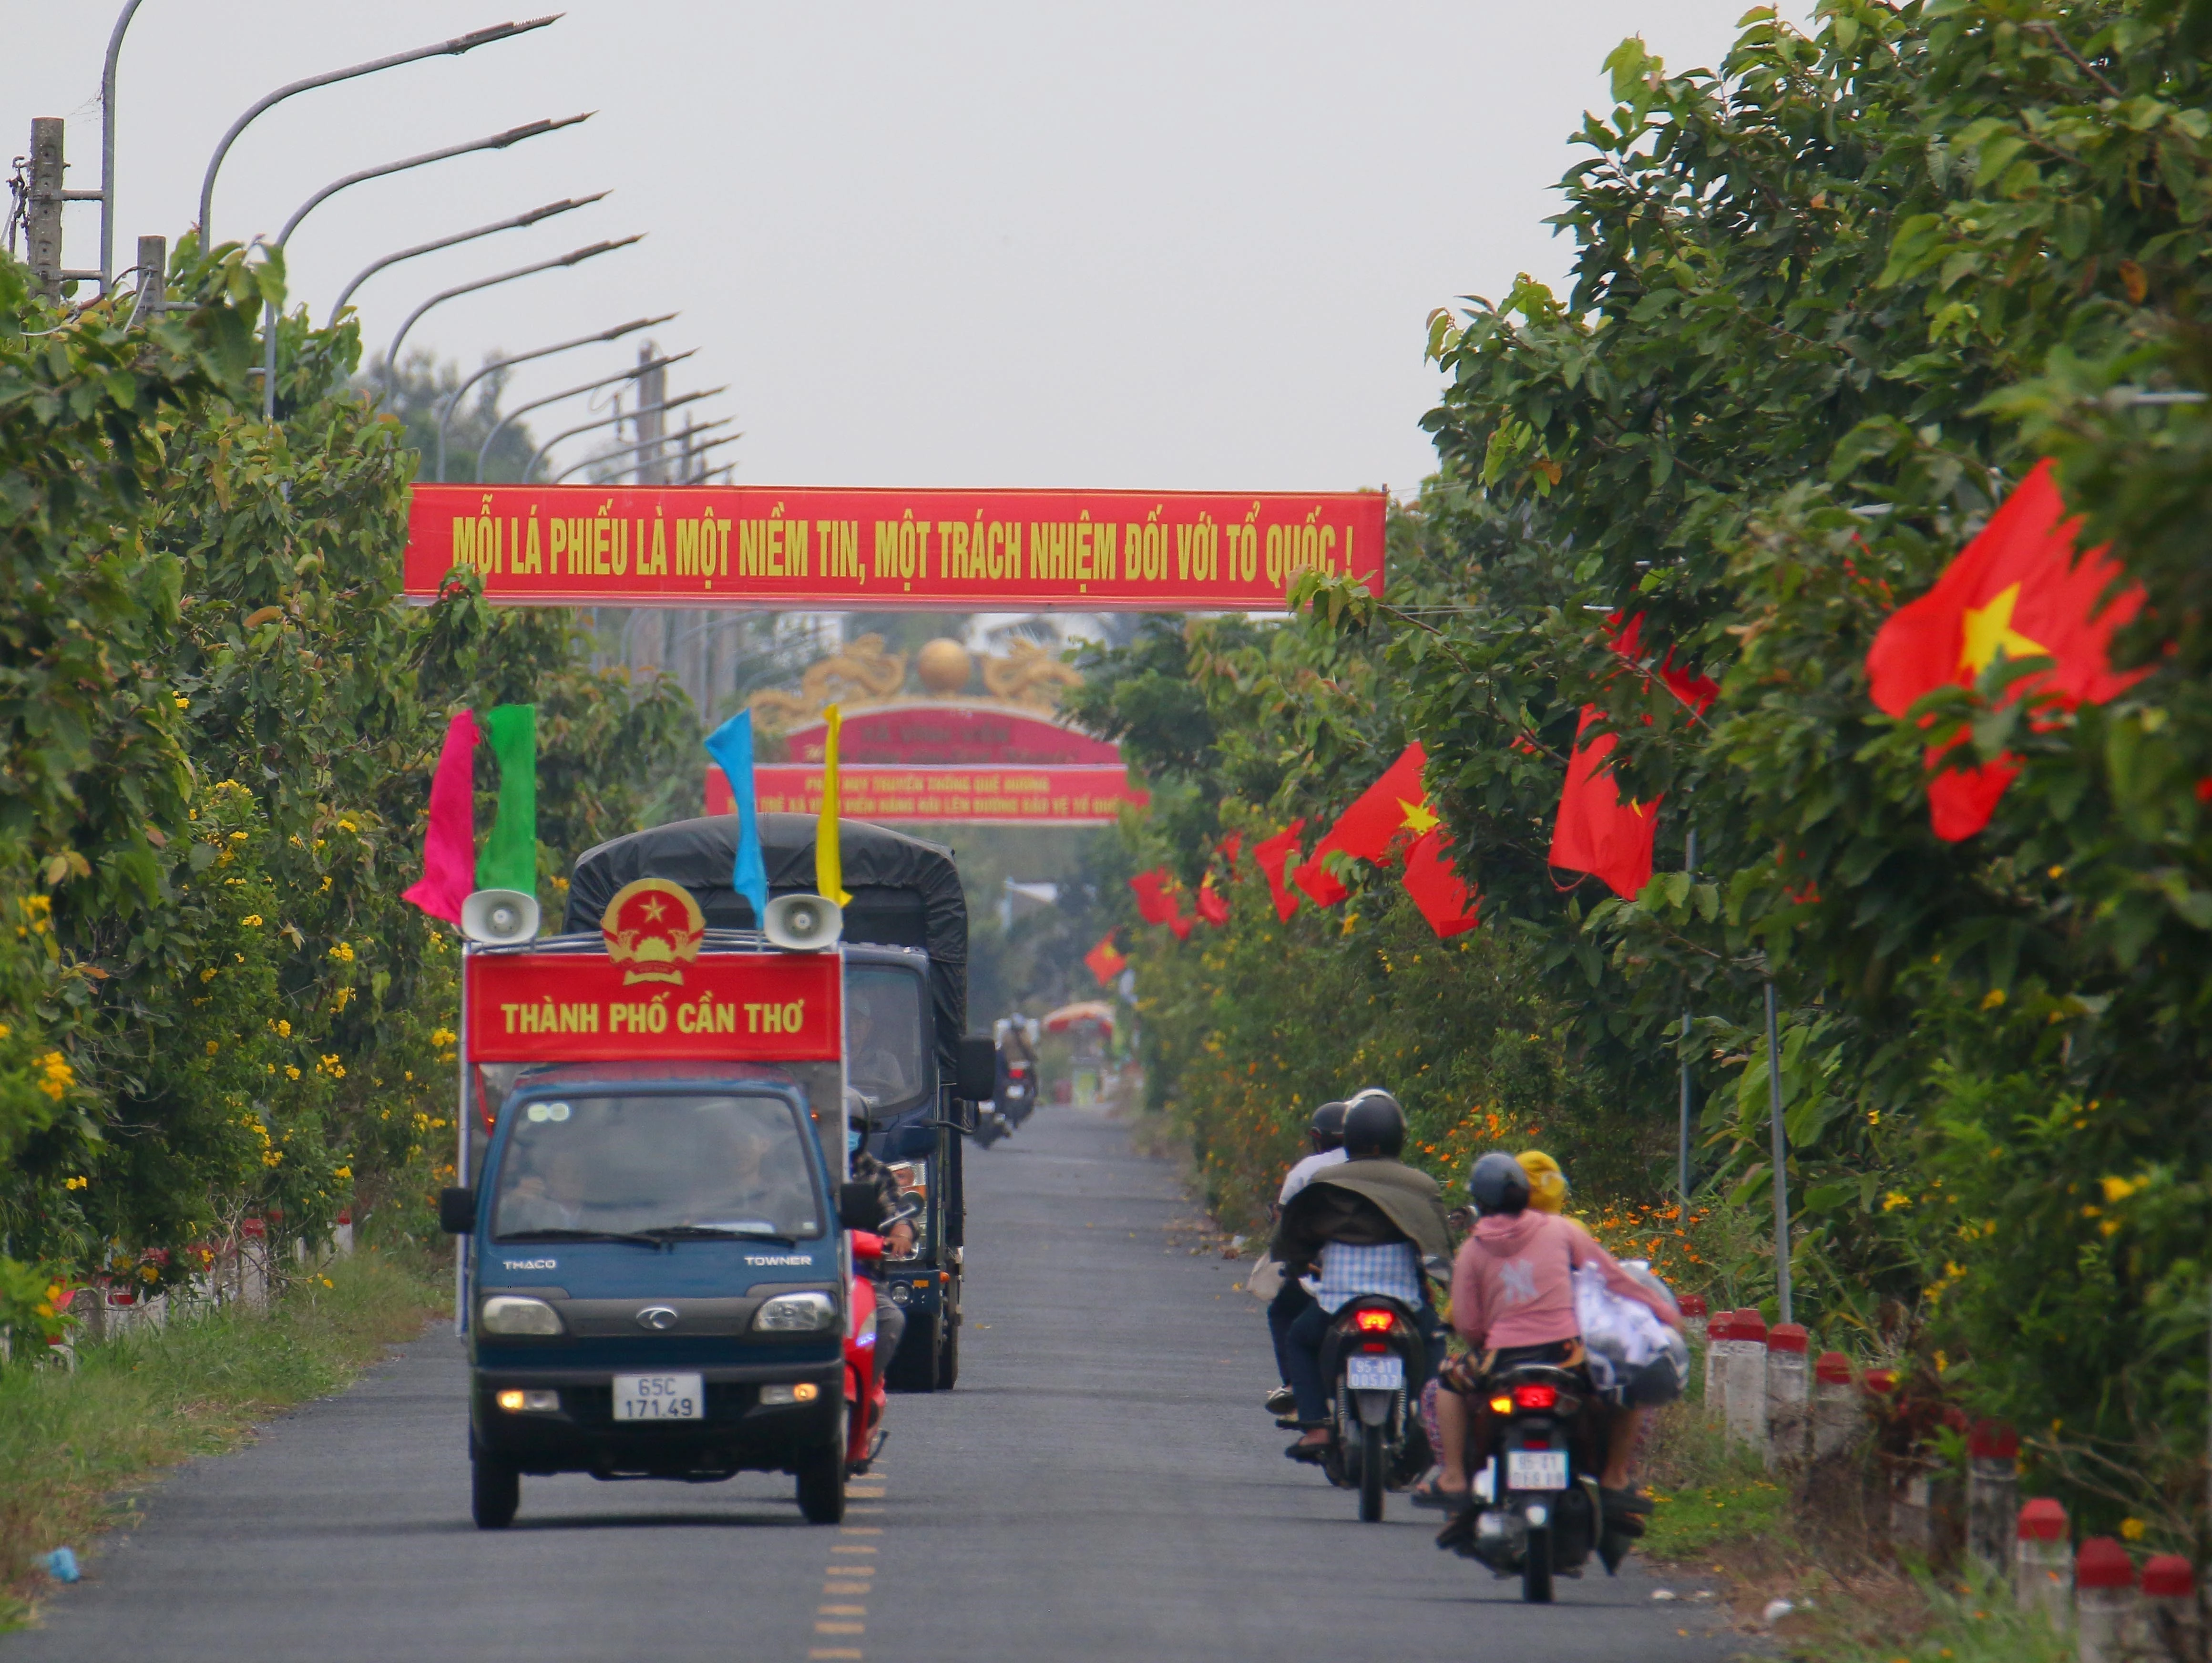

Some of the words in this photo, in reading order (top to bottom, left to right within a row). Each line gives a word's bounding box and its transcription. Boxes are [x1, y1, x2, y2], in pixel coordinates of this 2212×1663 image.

[452, 493, 502, 574] MỖI
[511, 504, 542, 574] LÁ
[550, 499, 628, 575] PHIẾU
[636, 506, 668, 575] LÀ
[676, 506, 732, 589] MỘT
[739, 502, 809, 576] NIỀM
[816, 520, 866, 585] TIN,
[874, 508, 931, 592] MỘT
[938, 508, 1022, 579] TRÁCH
[1030, 510, 1117, 593] NHIỆM
[1124, 504, 1169, 581] ĐỐI
[1177, 505, 1218, 581] VỚI
[1226, 501, 1261, 582] TỔ
[1265, 505, 1335, 589] QUỐC
[501, 996, 598, 1033] THÀNH
[610, 992, 669, 1033] PHỐ
[677, 991, 735, 1033] CẦN
[744, 999, 804, 1033] THƠ
[503, 1259, 556, 1270] THACO
[744, 1255, 811, 1266] TOWNER
[638, 1377, 676, 1396] 65C
[625, 1398, 693, 1418] 171.49
